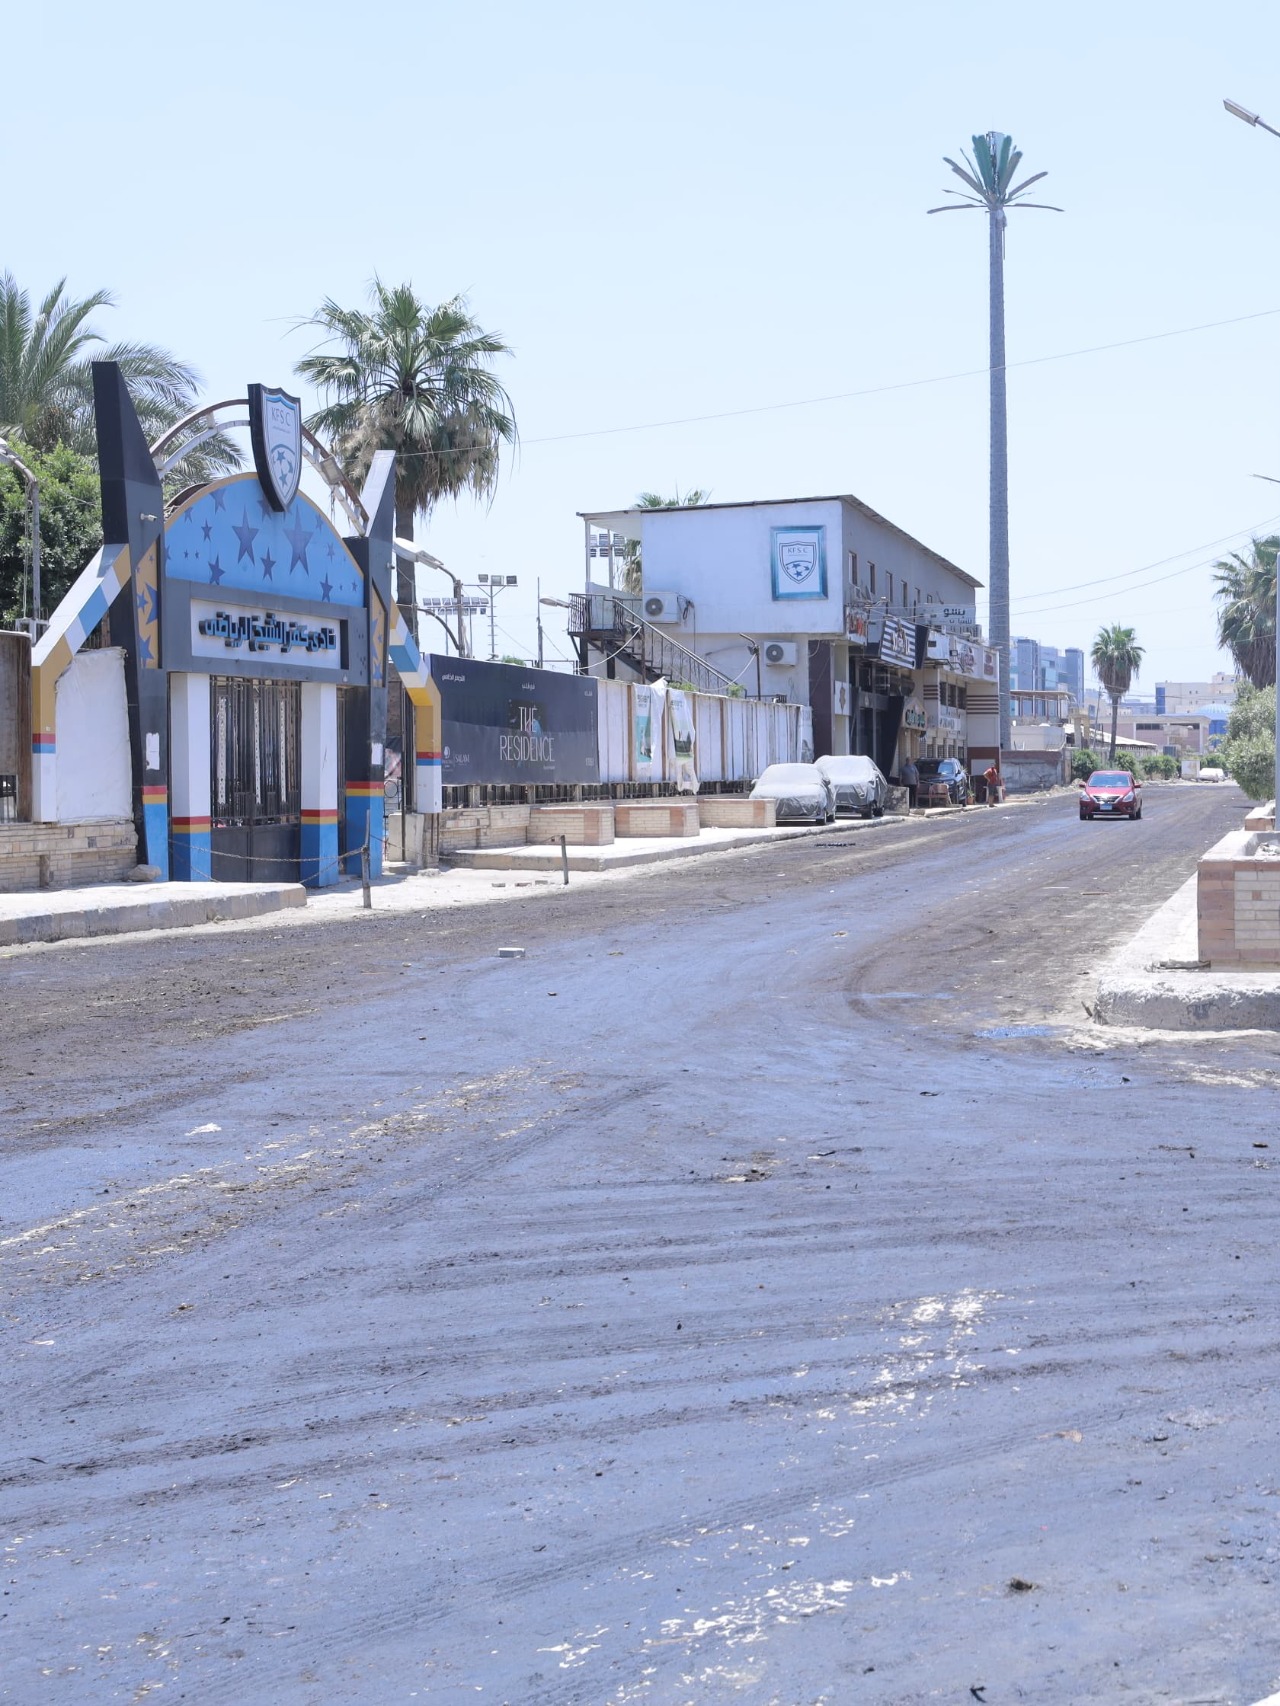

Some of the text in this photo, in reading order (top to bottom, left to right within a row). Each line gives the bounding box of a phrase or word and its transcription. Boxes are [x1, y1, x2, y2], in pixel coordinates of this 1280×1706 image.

[249, 612, 286, 652] الشيخ
[280, 621, 308, 653] كفر
[518, 706, 538, 732] THE
[500, 735, 555, 762] RESIDENCE
